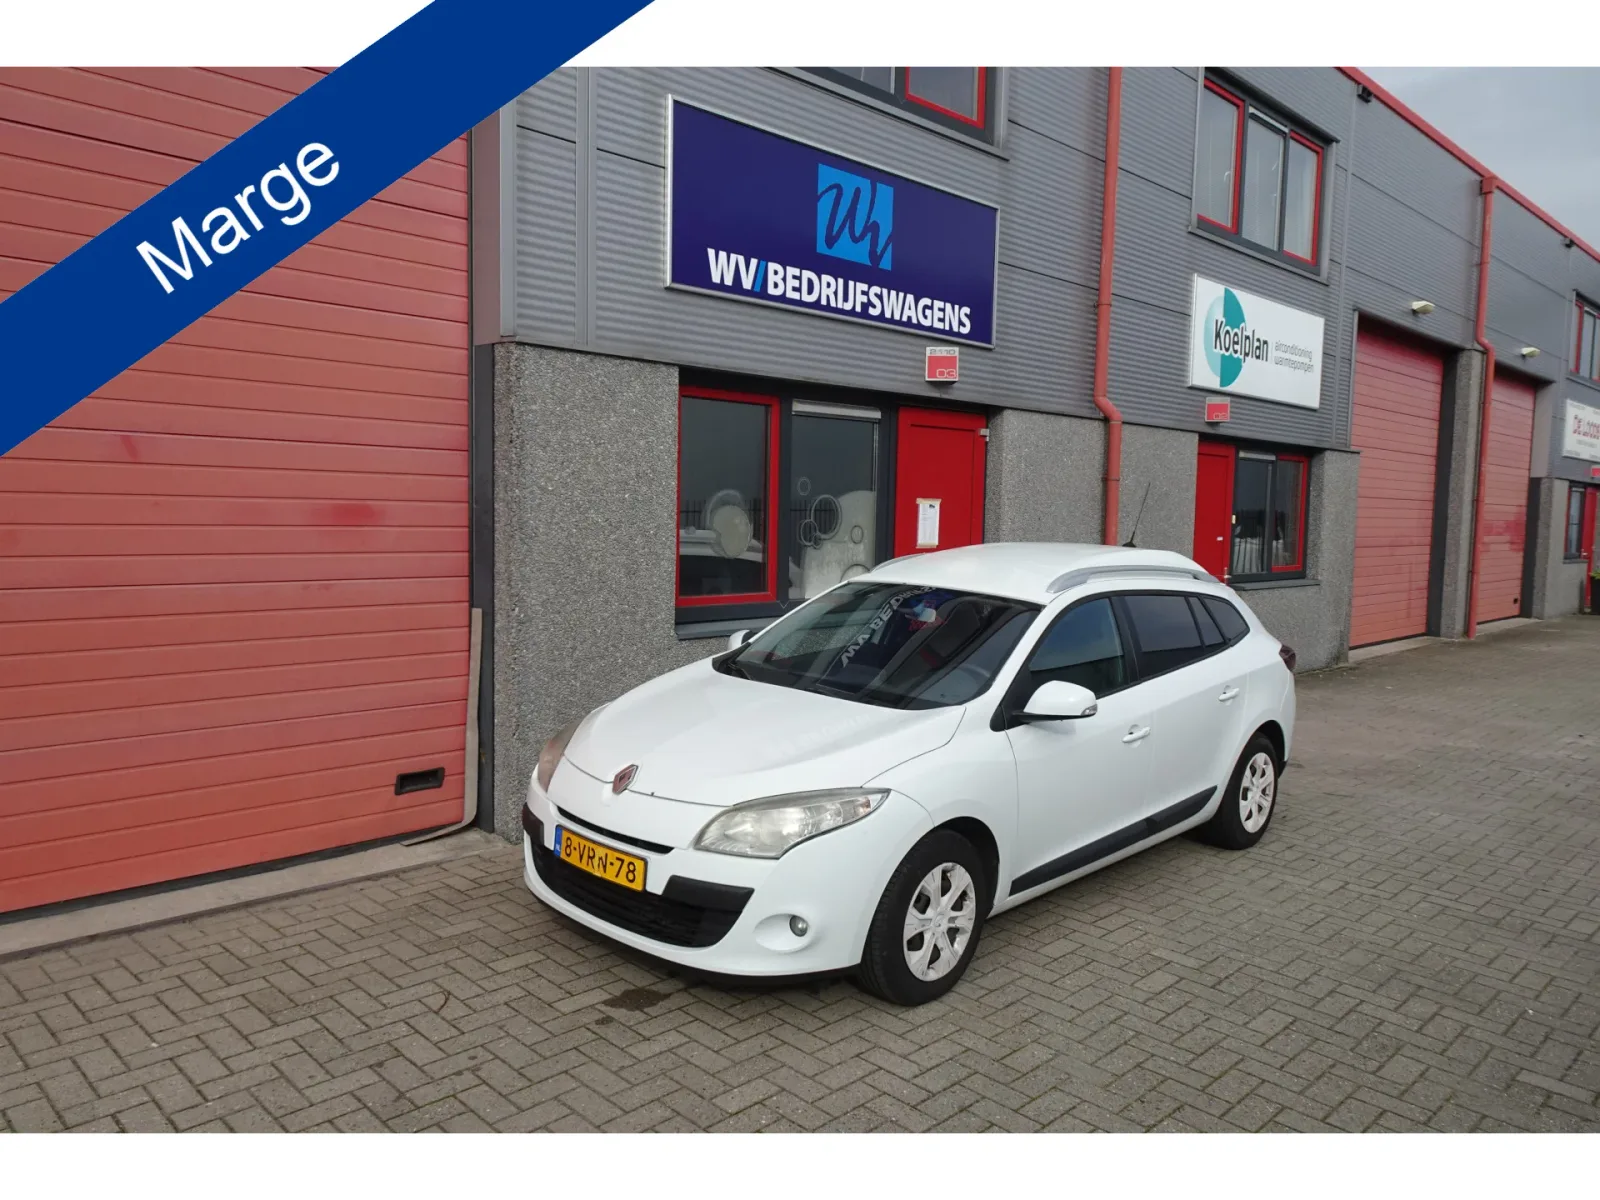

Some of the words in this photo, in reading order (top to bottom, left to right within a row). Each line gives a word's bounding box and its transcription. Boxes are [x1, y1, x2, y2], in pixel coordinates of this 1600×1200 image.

[1214, 319, 1269, 363] Koelplan
[1275, 340, 1312, 362] airconditioning
[936, 368, 957, 378] 03
[564, 836, 636, 883] 8-VRN-78
